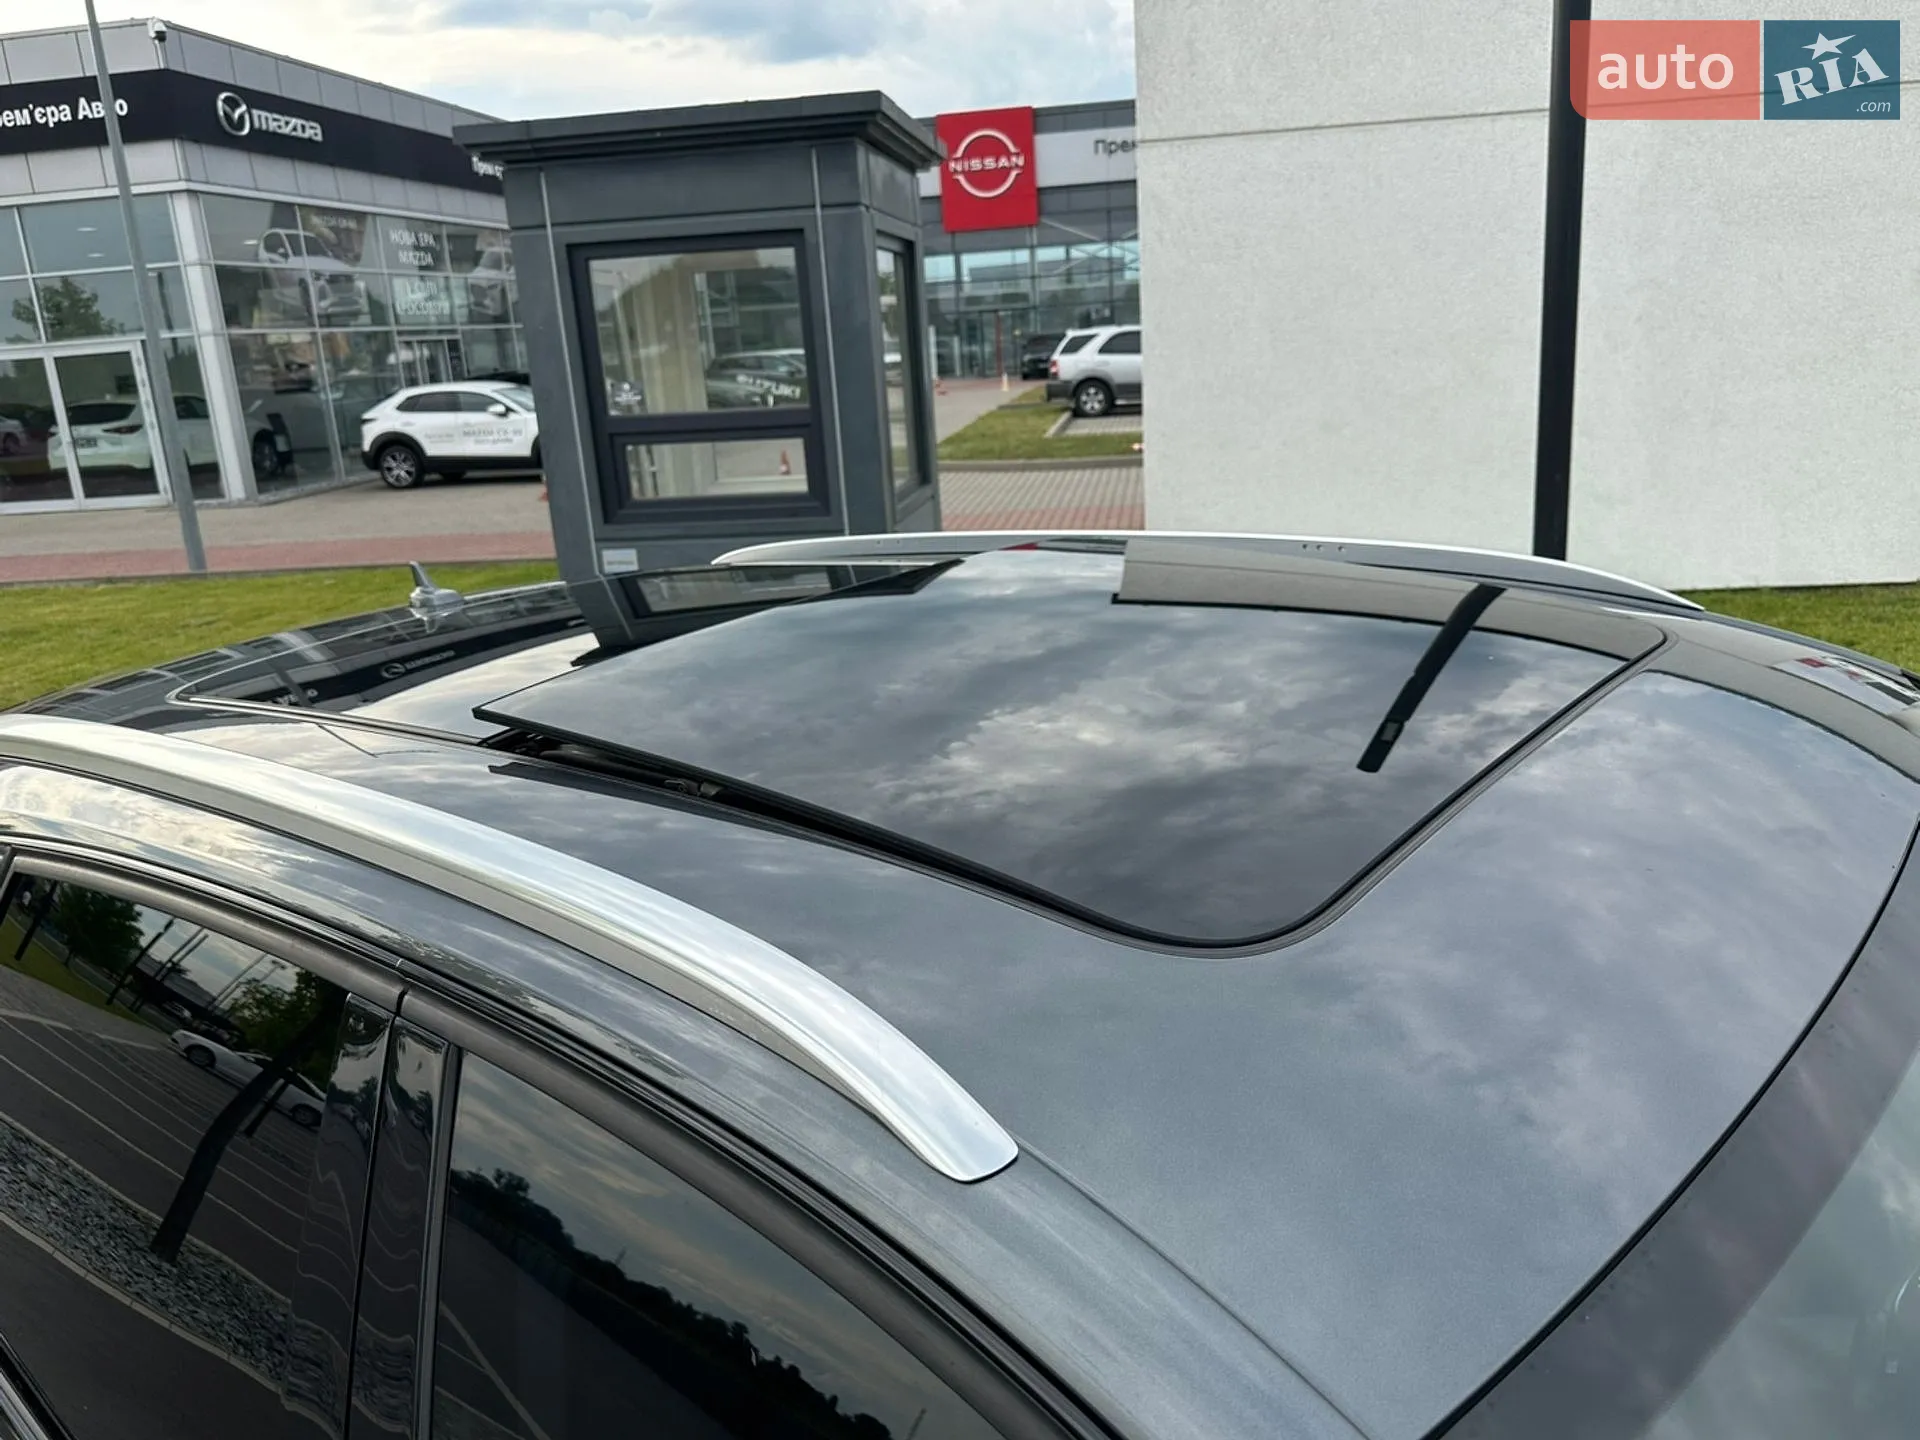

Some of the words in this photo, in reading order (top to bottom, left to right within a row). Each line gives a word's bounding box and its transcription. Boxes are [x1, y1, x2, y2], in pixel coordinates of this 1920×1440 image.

[0, 104, 72, 127] ем'єра
[78, 97, 128, 120] Аво
[949, 155, 1025, 173] NISSAN
